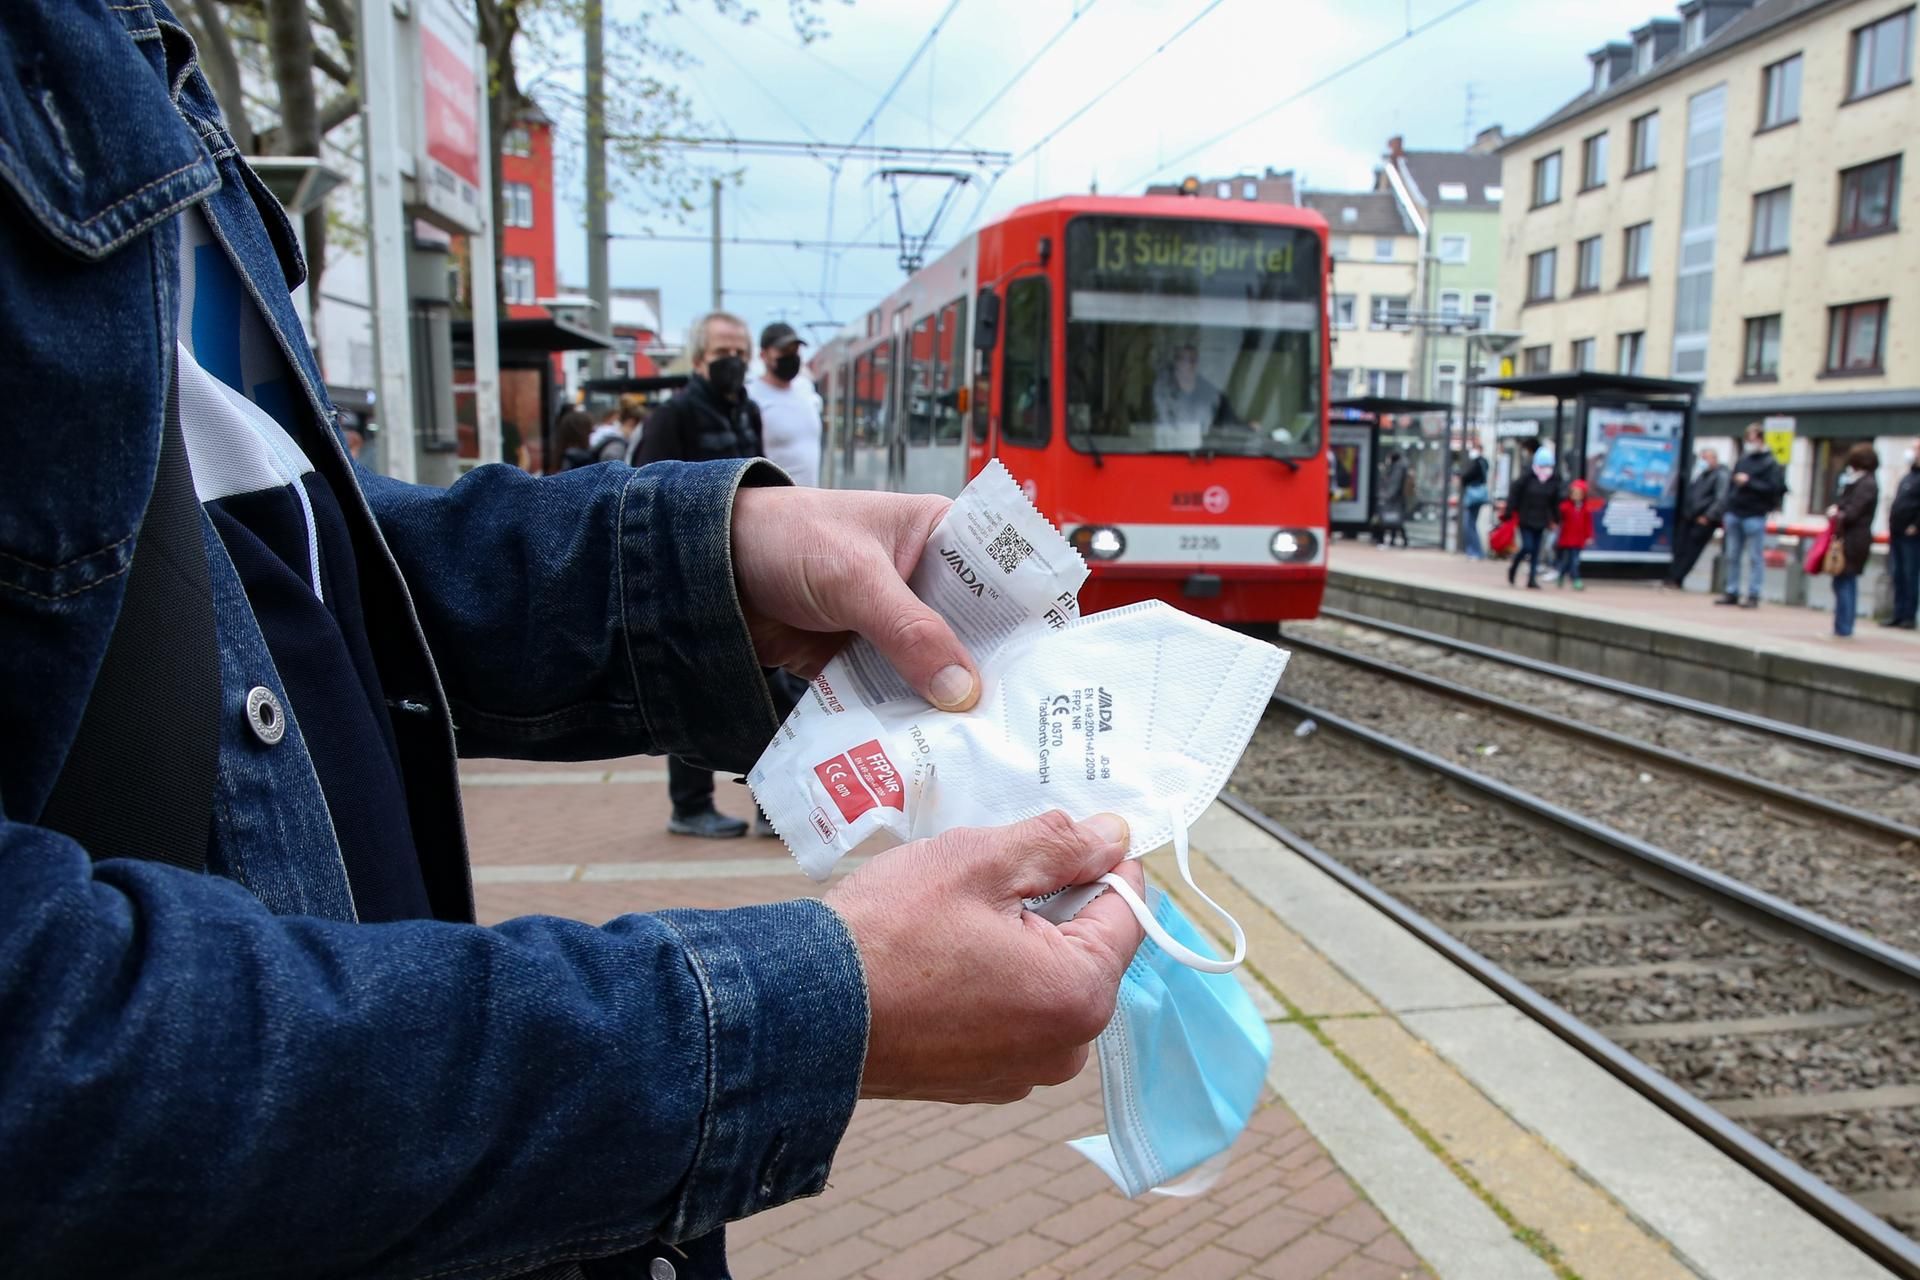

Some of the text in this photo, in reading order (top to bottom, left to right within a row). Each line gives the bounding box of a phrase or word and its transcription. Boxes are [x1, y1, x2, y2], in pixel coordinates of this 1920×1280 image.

[1096, 231, 1127, 271] 13
[940, 548, 985, 598] JIADA
[1072, 689, 1081, 731] FFP2 NR
[1084, 687, 1094, 700] EN
[1098, 686, 1113, 733] JIADA
[1038, 695, 1050, 785] Tradeforth GmbH
[1051, 721, 1063, 747] 0370
